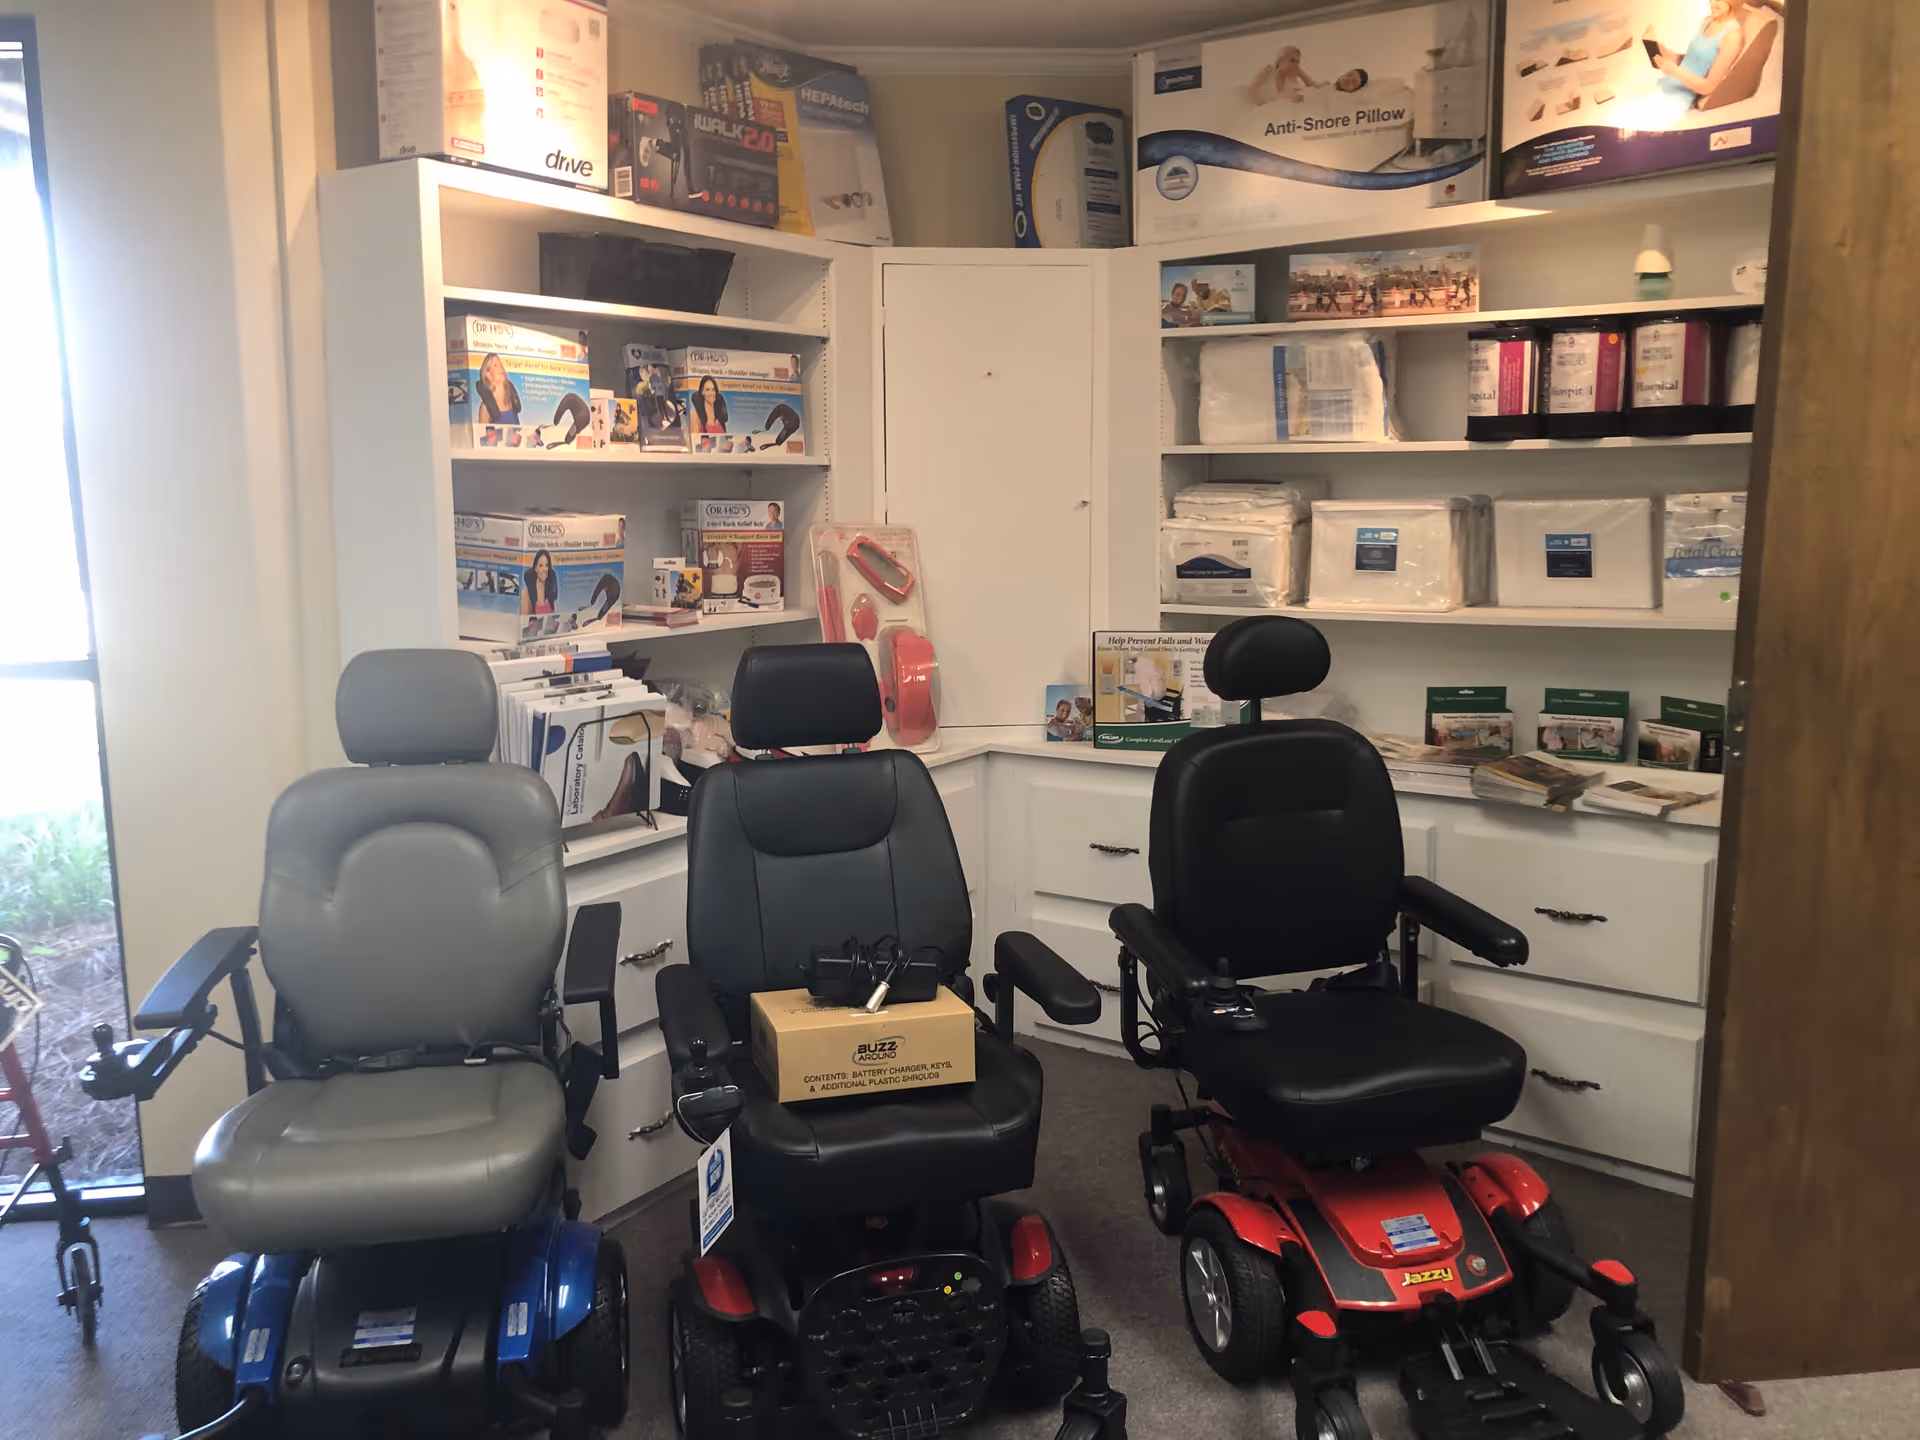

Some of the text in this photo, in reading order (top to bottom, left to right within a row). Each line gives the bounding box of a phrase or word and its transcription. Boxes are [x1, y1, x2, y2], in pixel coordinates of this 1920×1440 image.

[1264, 115, 1350, 136] Anti-Snore
[1355, 107, 1406, 125] Pillow
[545, 149, 594, 177] drive
[1108, 636, 1126, 646] Help
[1127, 637, 1156, 645] Prevent
[1158, 637, 1175, 645] Falls
[1177, 637, 1192, 645] and
[571, 763, 584, 815] Laboratory
[857, 1041, 898, 1054] BUZZ
[858, 1051, 897, 1062] AROUND
[804, 1061, 952, 1084] CONTENTS: BATTERY CHARGER, KEYS,
[820, 1081, 867, 1091] ADDITIONAL
[868, 1076, 900, 1086] PLASTIC
[902, 1071, 940, 1083] SHROUDS
[1401, 1267, 1454, 1287] Jazzy
